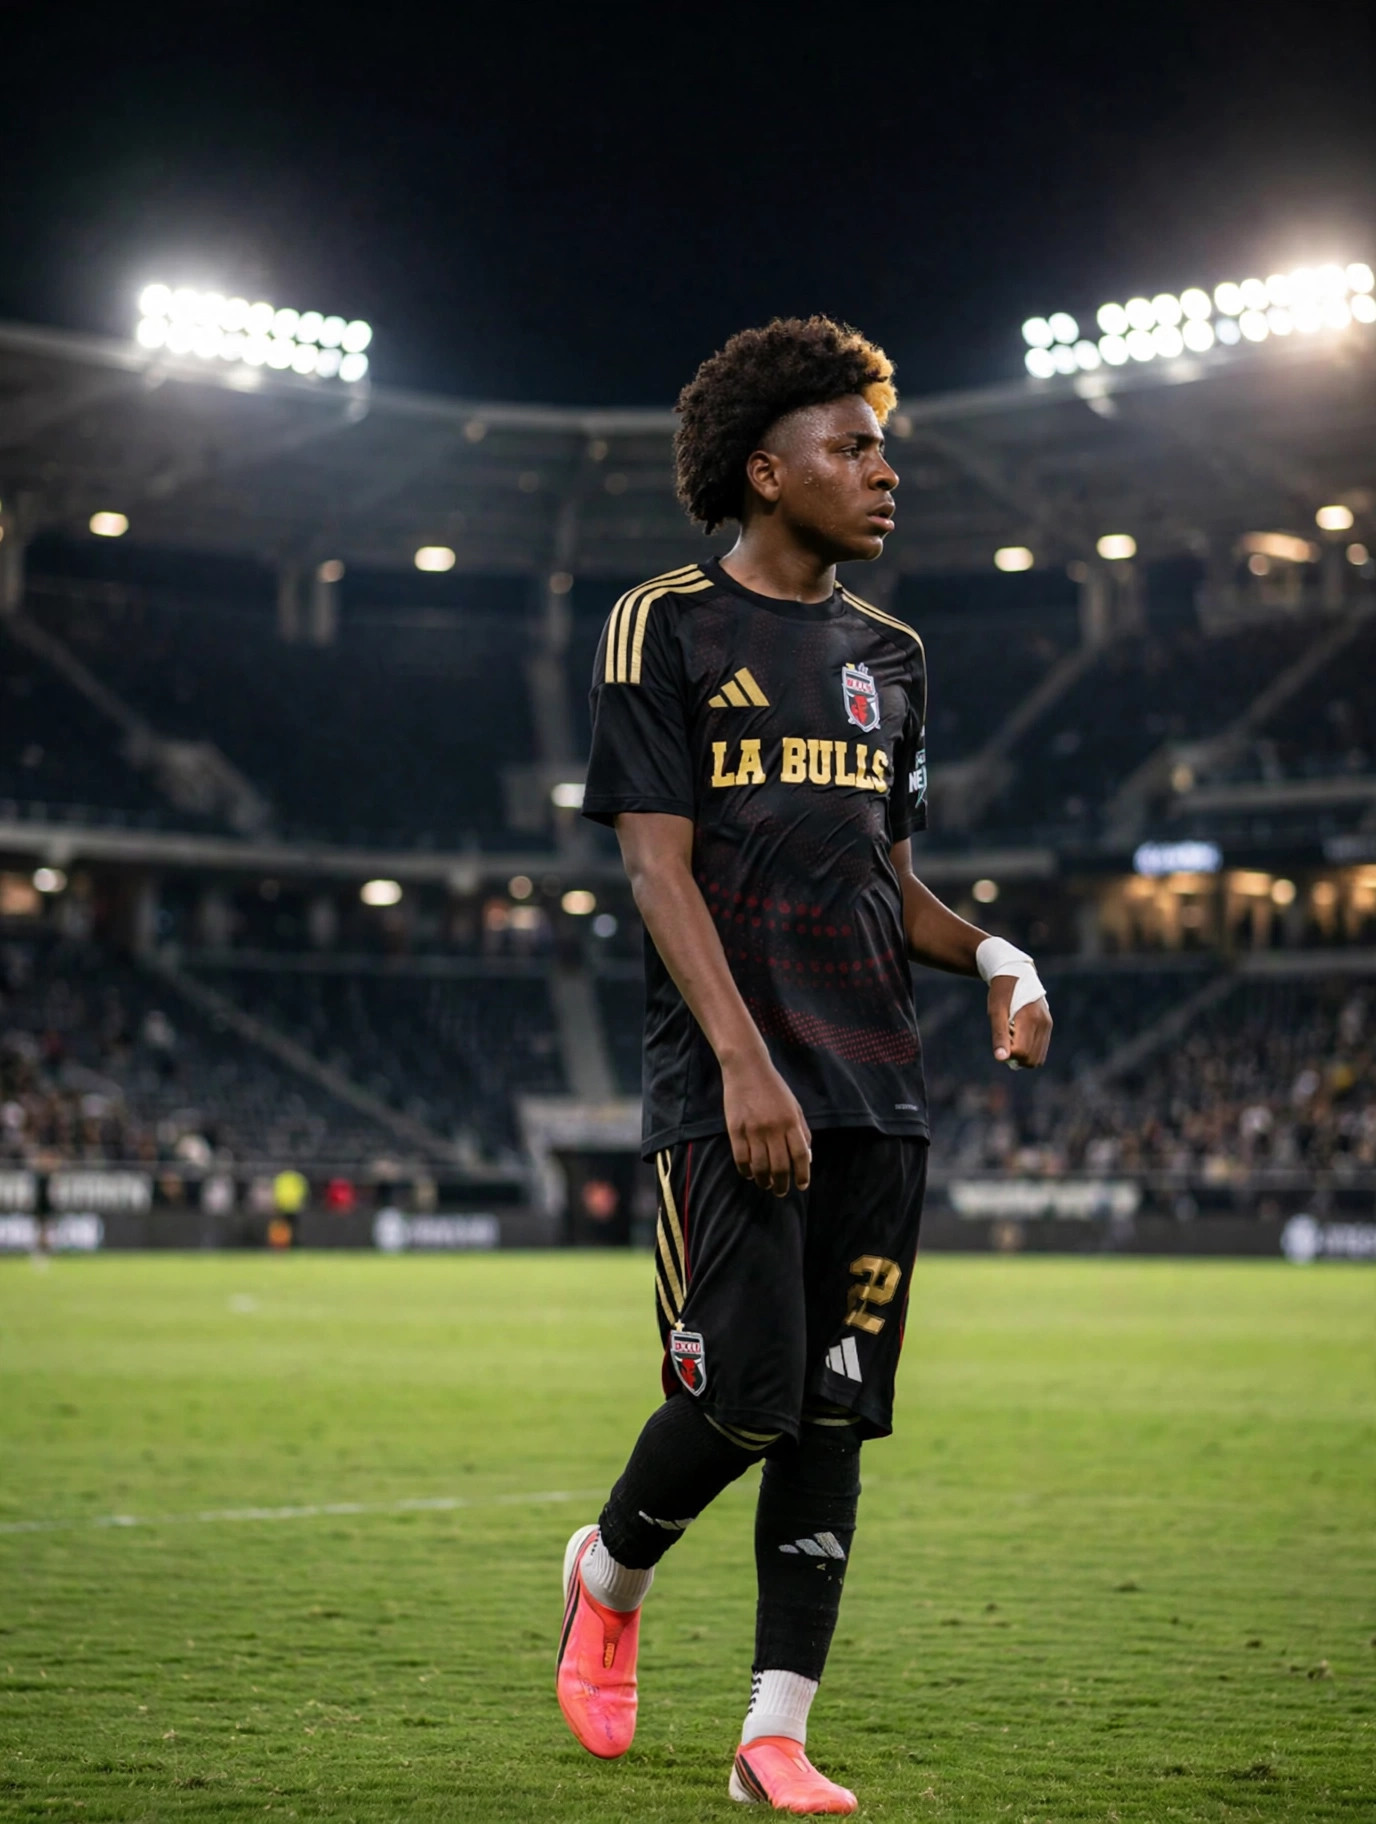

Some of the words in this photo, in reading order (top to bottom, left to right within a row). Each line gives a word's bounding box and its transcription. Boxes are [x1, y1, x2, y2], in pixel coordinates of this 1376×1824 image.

[711, 739, 766, 788] LA
[780, 737, 889, 793] BULLS
[844, 1254, 902, 1336] 2
